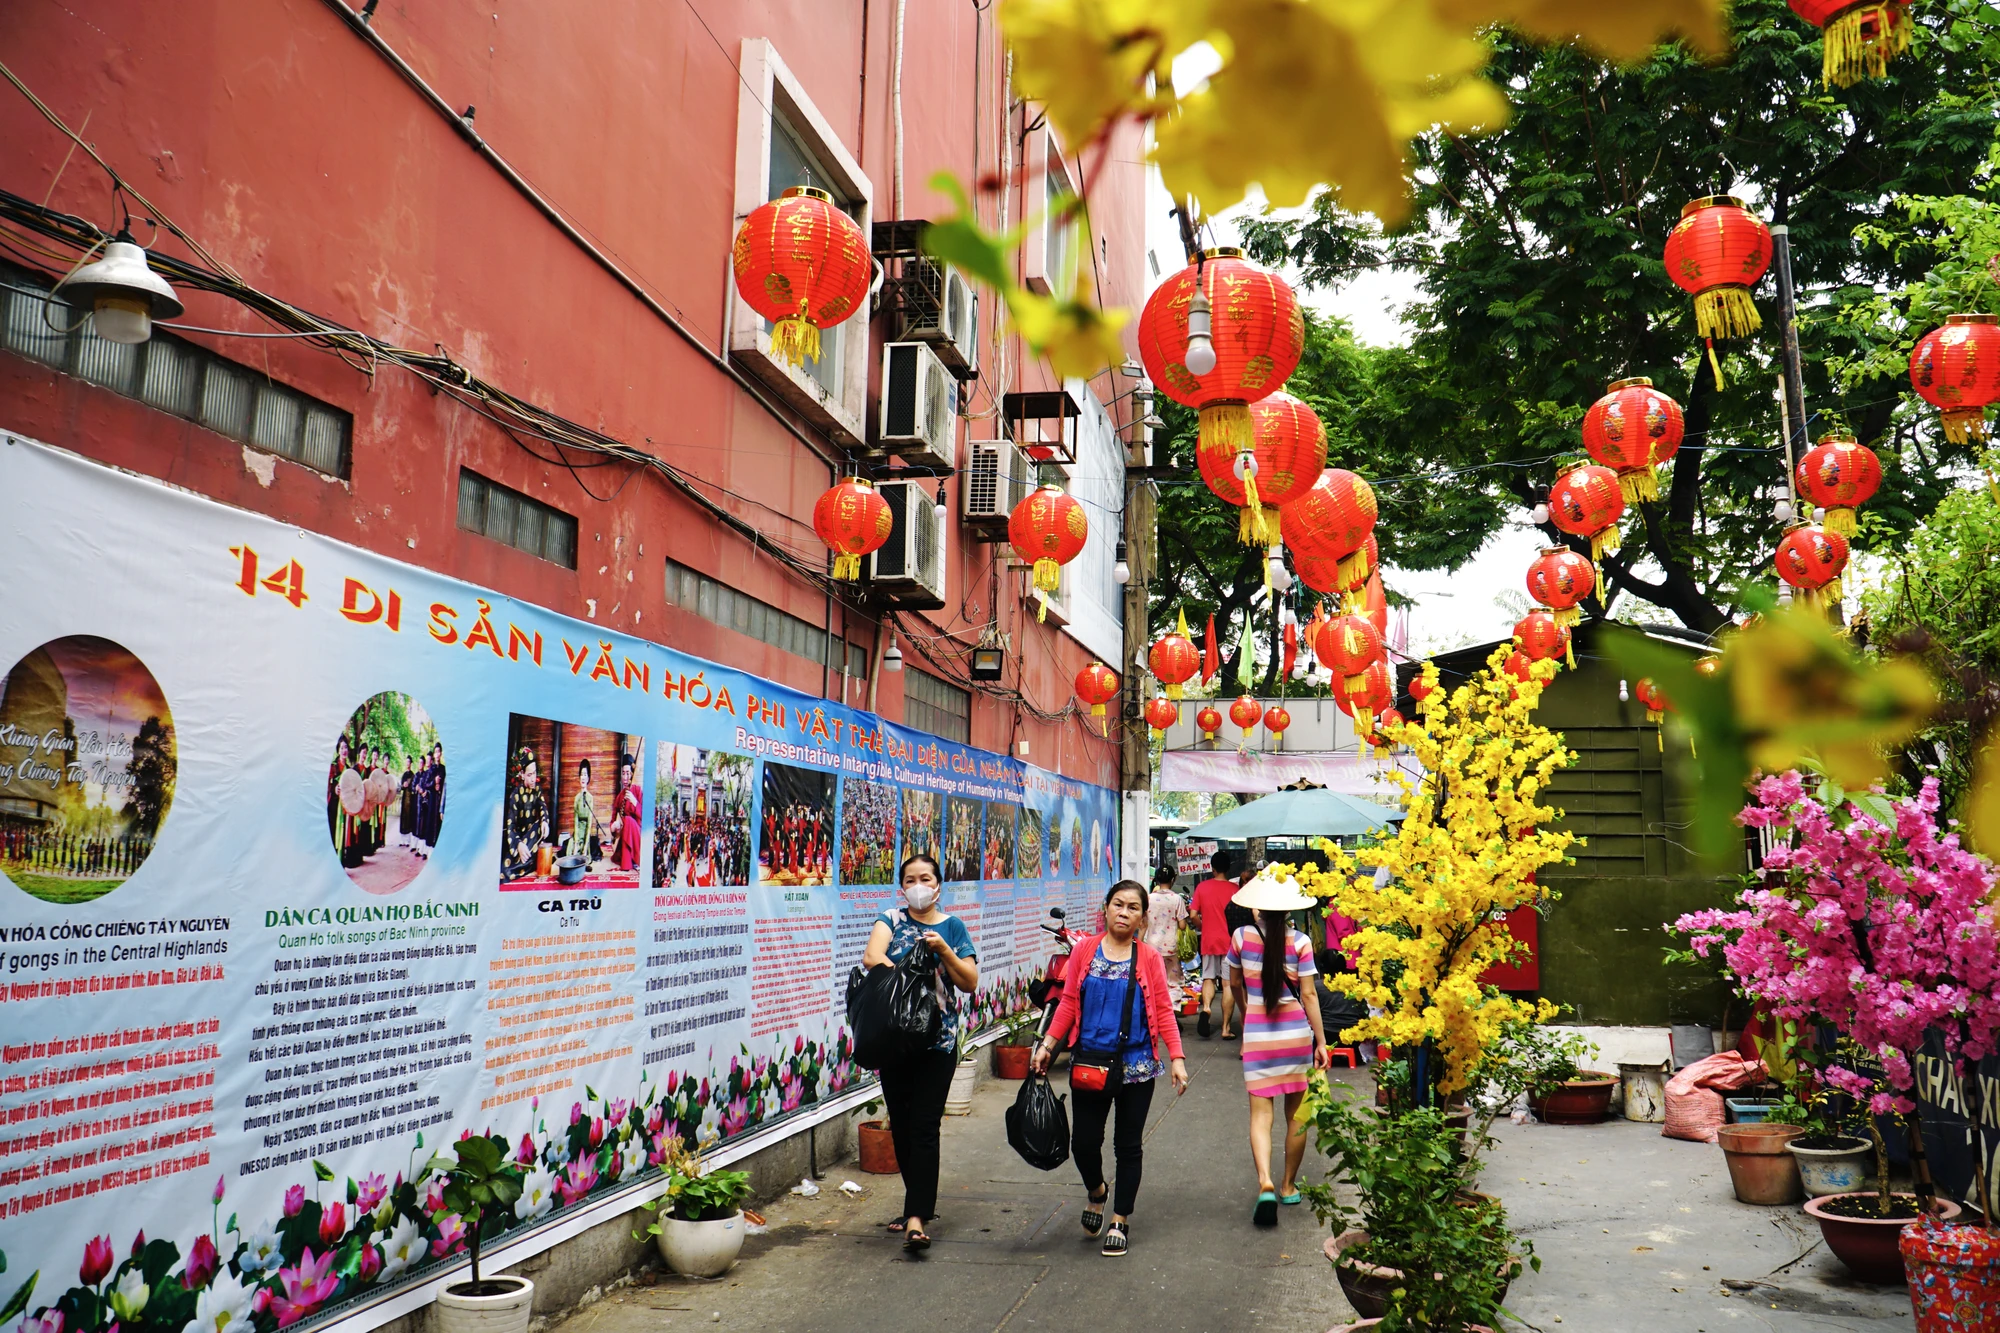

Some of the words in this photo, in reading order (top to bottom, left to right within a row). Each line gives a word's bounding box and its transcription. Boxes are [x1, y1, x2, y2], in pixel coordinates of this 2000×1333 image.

[229, 543, 309, 610] 14
[339, 576, 402, 633] DI
[427, 598, 543, 669] SẢN
[561, 637, 649, 694] VĂN
[663, 668, 736, 716] HÓA
[746, 693, 786, 730] PHI
[795, 707, 843, 745] VẬT
[848, 720, 883, 754] THỂ
[887, 736, 913, 767] ĐẠI
[918, 742, 948, 774] DIỆN
[952, 748, 977, 777] CỦA
[42, 728, 74, 756] Gian
[735, 726, 841, 769] Representative
[843, 752, 892, 780] Intangible
[894, 765, 924, 786] Cultural
[926, 772, 956, 794] Heritage
[958, 780, 965, 792] of
[966, 782, 996, 800] Humanity
[265, 906, 306, 928] DÂN
[308, 907, 331, 926] CA
[336, 905, 383, 925] QUAN
[387, 903, 410, 923] HỌ
[413, 898, 443, 920] BẮC
[446, 902, 479, 918] NINH
[538, 900, 563, 912] CA
[569, 896, 602, 911] TRÙ
[11, 923, 45, 941] HÓA
[95, 920, 145, 937] CHIÊNG
[149, 918, 177, 934] TÂY
[179, 916, 229, 932] NGUYÊN
[560, 918, 568, 927] Ca
[570, 916, 579, 927] Tru
[279, 935, 306, 948] Quan
[310, 933, 323, 945] Ho
[327, 932, 344, 944] folk
[348, 932, 376, 945] songs
[379, 928, 388, 941] of
[390, 928, 407, 940] Bac
[409, 926, 428, 938] Ninh
[431, 925, 465, 940] province
[9, 953, 58, 973] gongs
[64, 948, 77, 964] in
[83, 947, 105, 963] the
[111, 943, 160, 961] Central
[164, 939, 227, 960] Highlands
